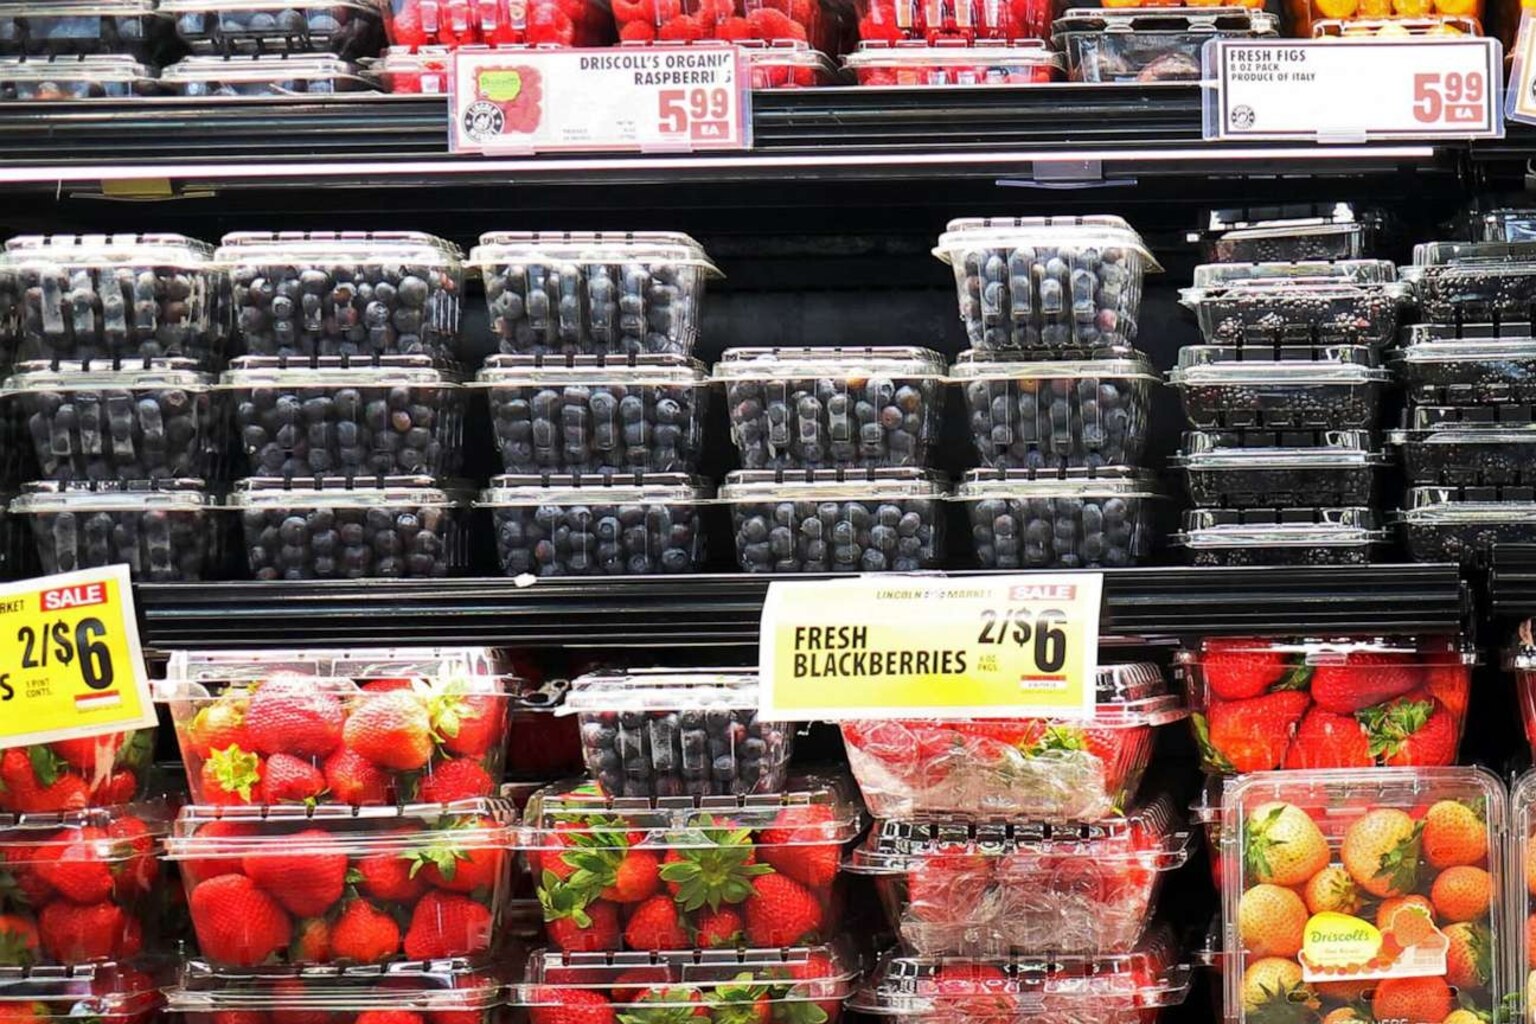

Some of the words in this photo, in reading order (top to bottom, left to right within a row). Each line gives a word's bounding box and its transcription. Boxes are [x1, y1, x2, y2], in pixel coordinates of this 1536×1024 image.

[580, 54, 660, 70] DRISCOLL'S
[1230, 50, 1271, 62] FRESH
[1277, 49, 1306, 62] FIGS
[1239, 63, 1252, 71] OZ
[1255, 63, 1280, 71] PACK
[1231, 73, 1274, 82] PRODUCE
[1277, 73, 1289, 81] OF
[1291, 72, 1316, 82] ITALY
[45, 585, 103, 609] SALE
[1012, 585, 1071, 600] SALE
[794, 626, 868, 650] FRESH
[793, 650, 968, 679] BLACKBERRIES
